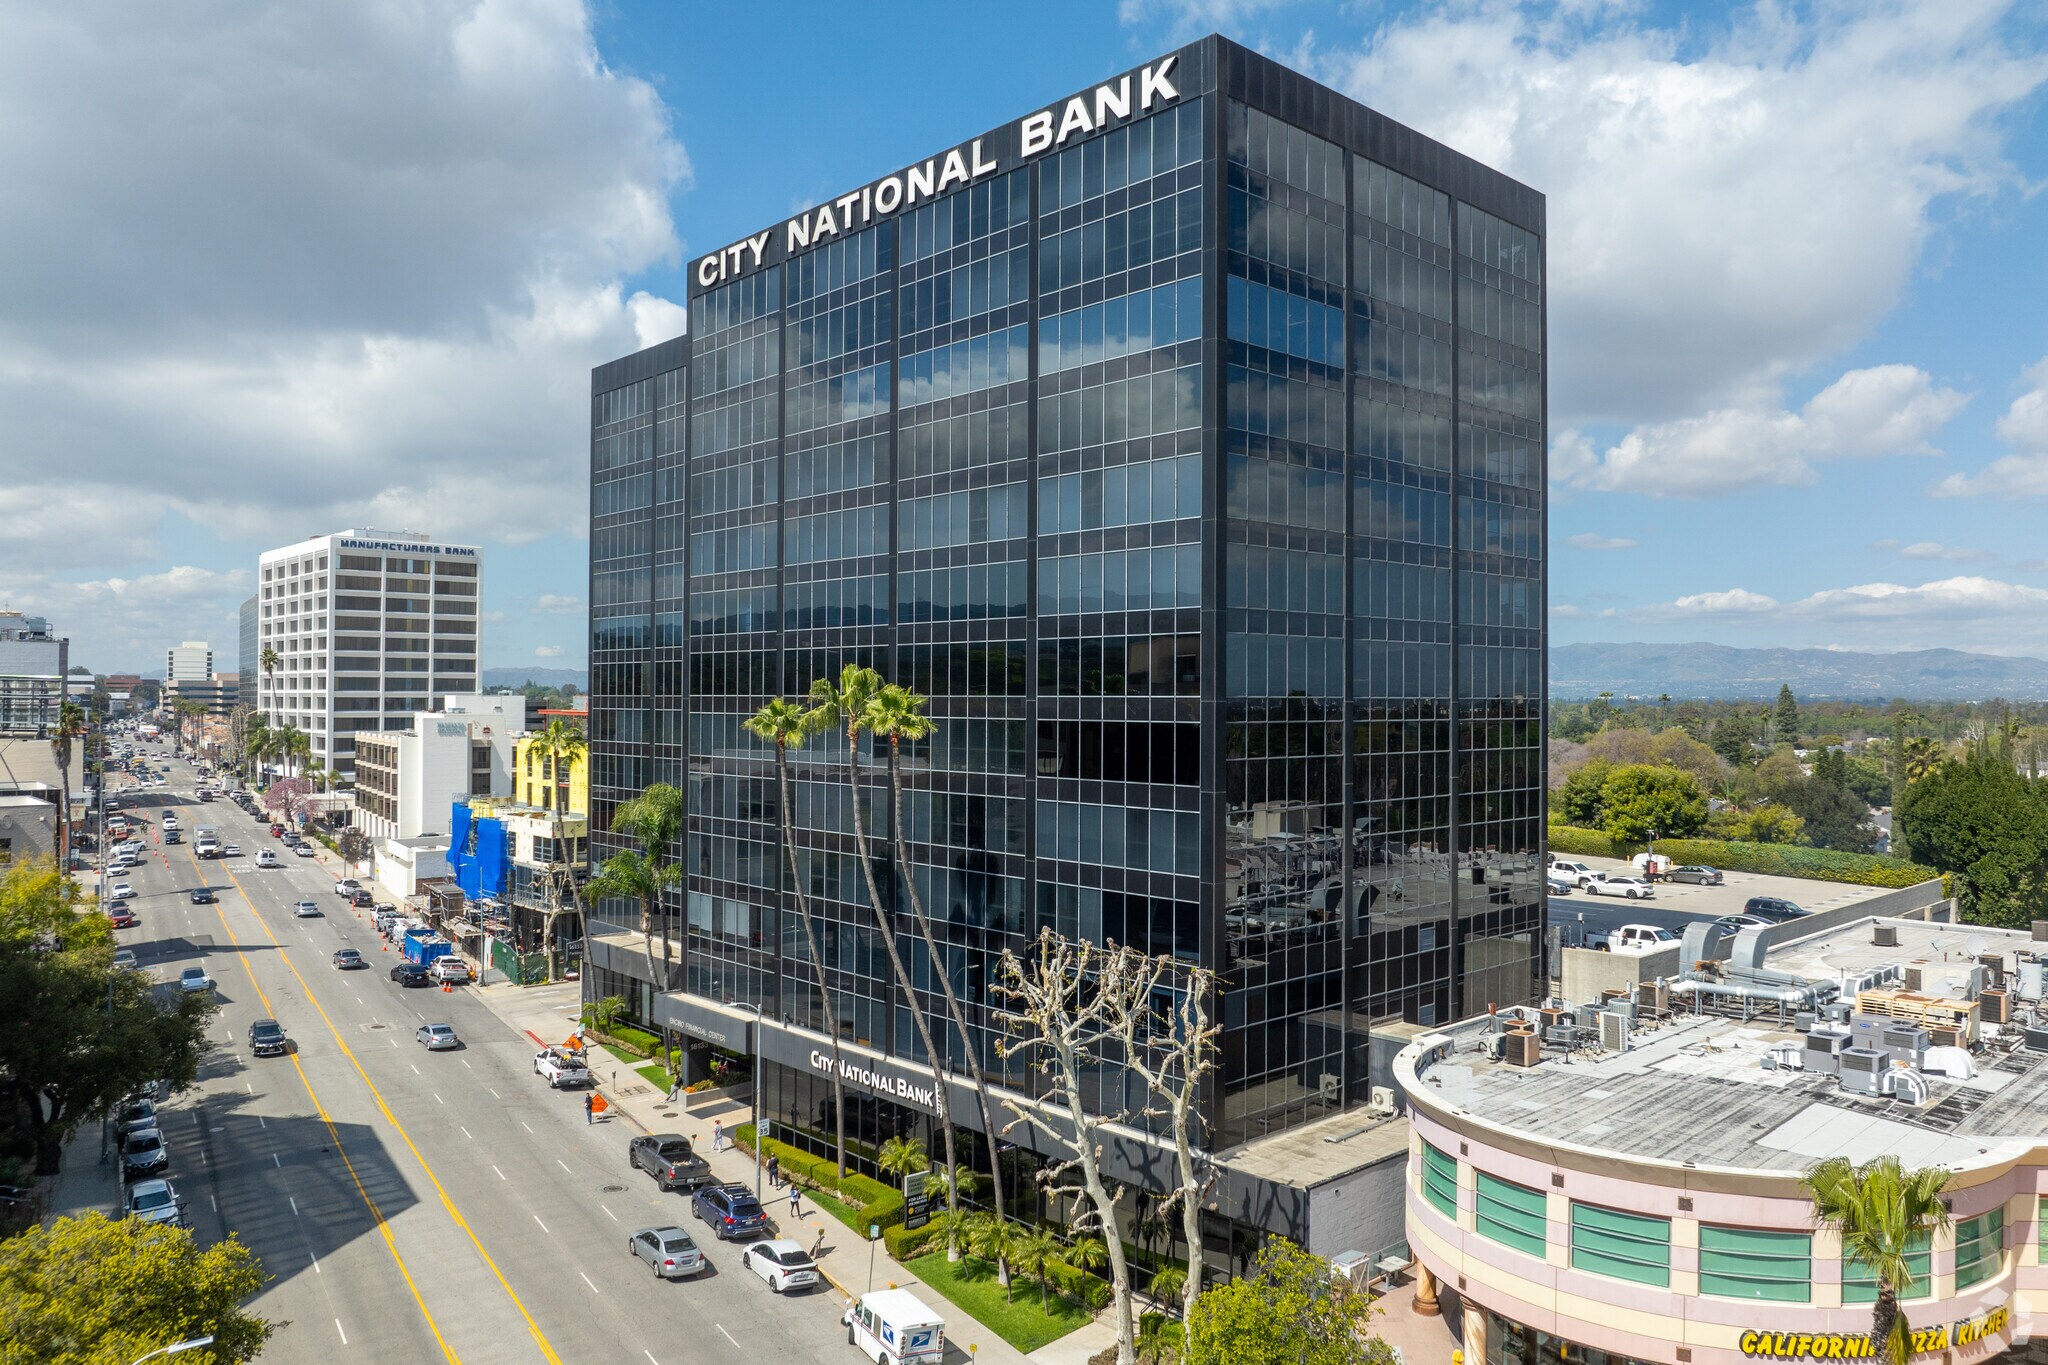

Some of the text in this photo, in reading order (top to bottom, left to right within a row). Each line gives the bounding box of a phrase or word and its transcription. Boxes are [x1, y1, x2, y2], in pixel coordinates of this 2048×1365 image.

[699, 55, 1180, 287] CITY NATIONAL BANK
[340, 539, 475, 556] MANUFACTURERS BANK
[669, 1017, 726, 1043] ENCINO FINANCIAL CENTER
[690, 1041, 709, 1050] 16133
[810, 1050, 934, 1108] CITY NATIONAL BANK
[759, 1127, 769, 1136] 35
[1910, 1329, 1948, 1353] IZZA
[1957, 1308, 2008, 1346] KITCHEN
